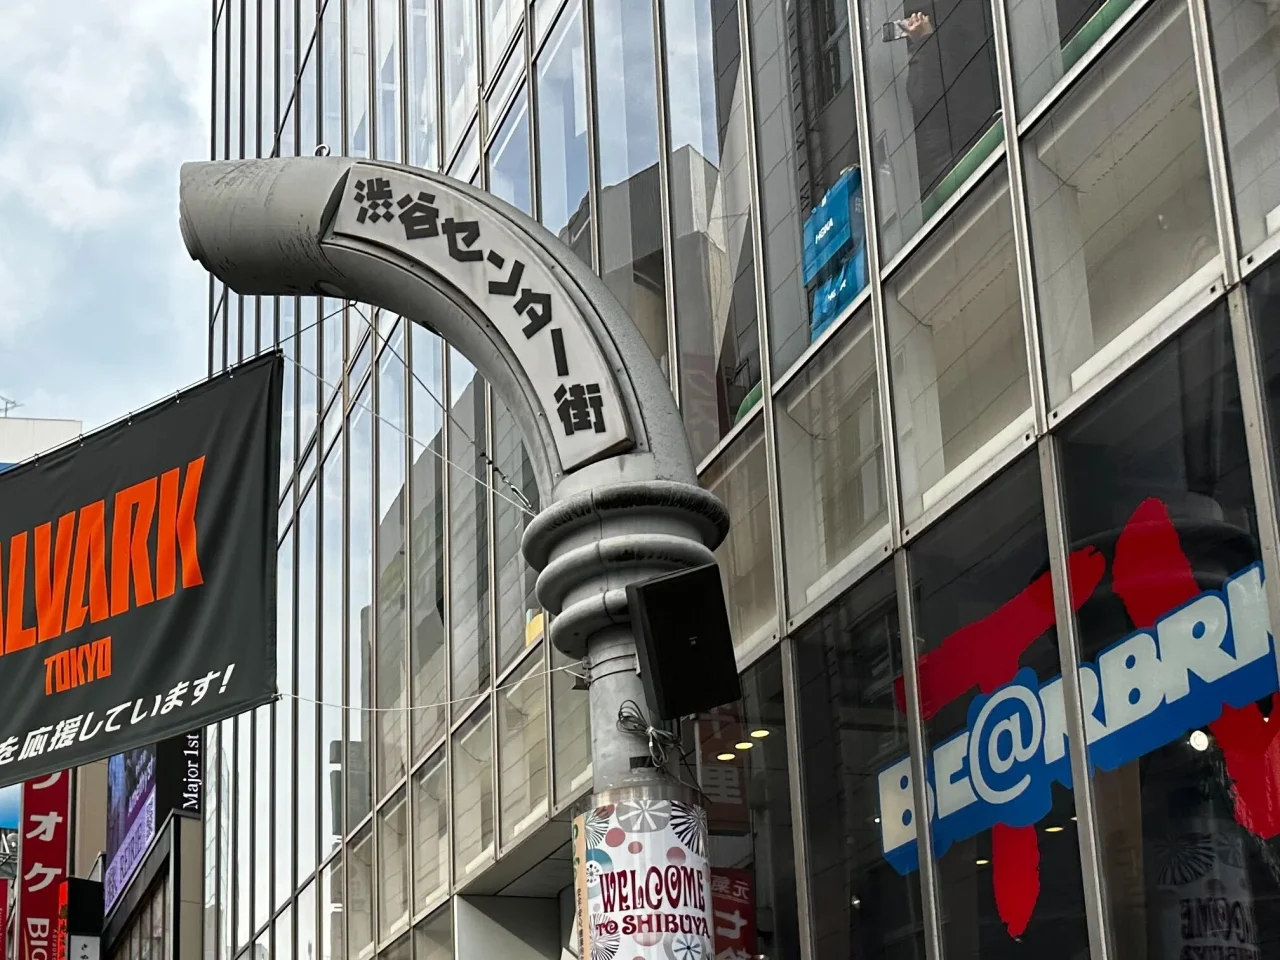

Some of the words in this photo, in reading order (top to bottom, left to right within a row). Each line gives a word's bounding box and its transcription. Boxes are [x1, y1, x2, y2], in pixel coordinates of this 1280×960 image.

[353, 177, 606, 437] 渋谷センター街
[44, 635, 111, 695] TOKYO
[879, 566, 1273, 854] BE@RBRI
[183, 734, 200, 759] 1st
[183, 760, 202, 810] Major
[599, 865, 706, 913] WELCOME
[622, 914, 710, 938] SHIBUYA
